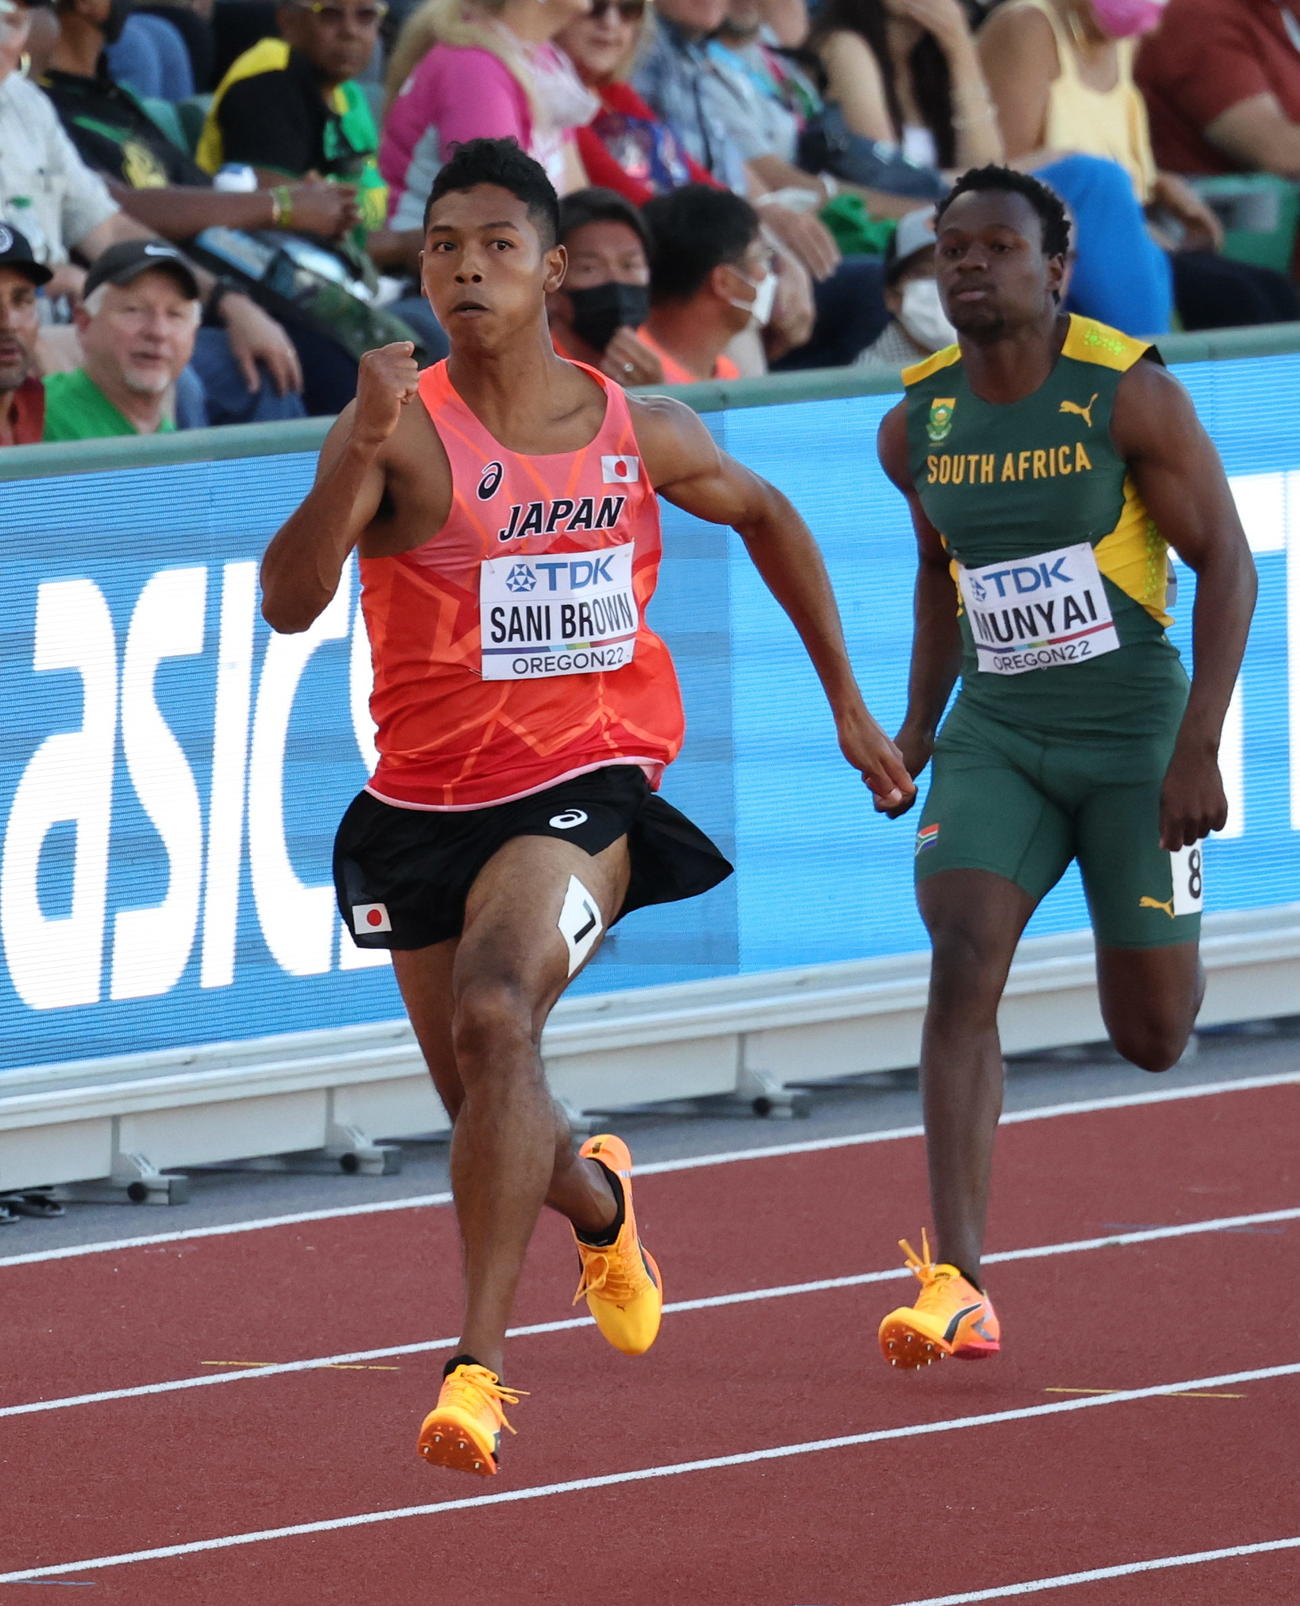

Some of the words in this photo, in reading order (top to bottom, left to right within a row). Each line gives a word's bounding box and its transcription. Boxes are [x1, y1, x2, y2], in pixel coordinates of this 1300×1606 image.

[926, 453, 995, 485] SOUTH
[1000, 441, 1093, 483] AFRICA
[497, 496, 629, 543] JAPAN
[535, 554, 617, 591] TDK
[982, 556, 1074, 598] TDK
[490, 604, 551, 643] SANI
[560, 592, 635, 639] BROWN
[972, 589, 1099, 644] MUNYAI
[512, 646, 625, 675] OREGON22
[993, 640, 1093, 672] OREGON22
[2, 548, 393, 1011] asic
[1188, 848, 1202, 900] 8
